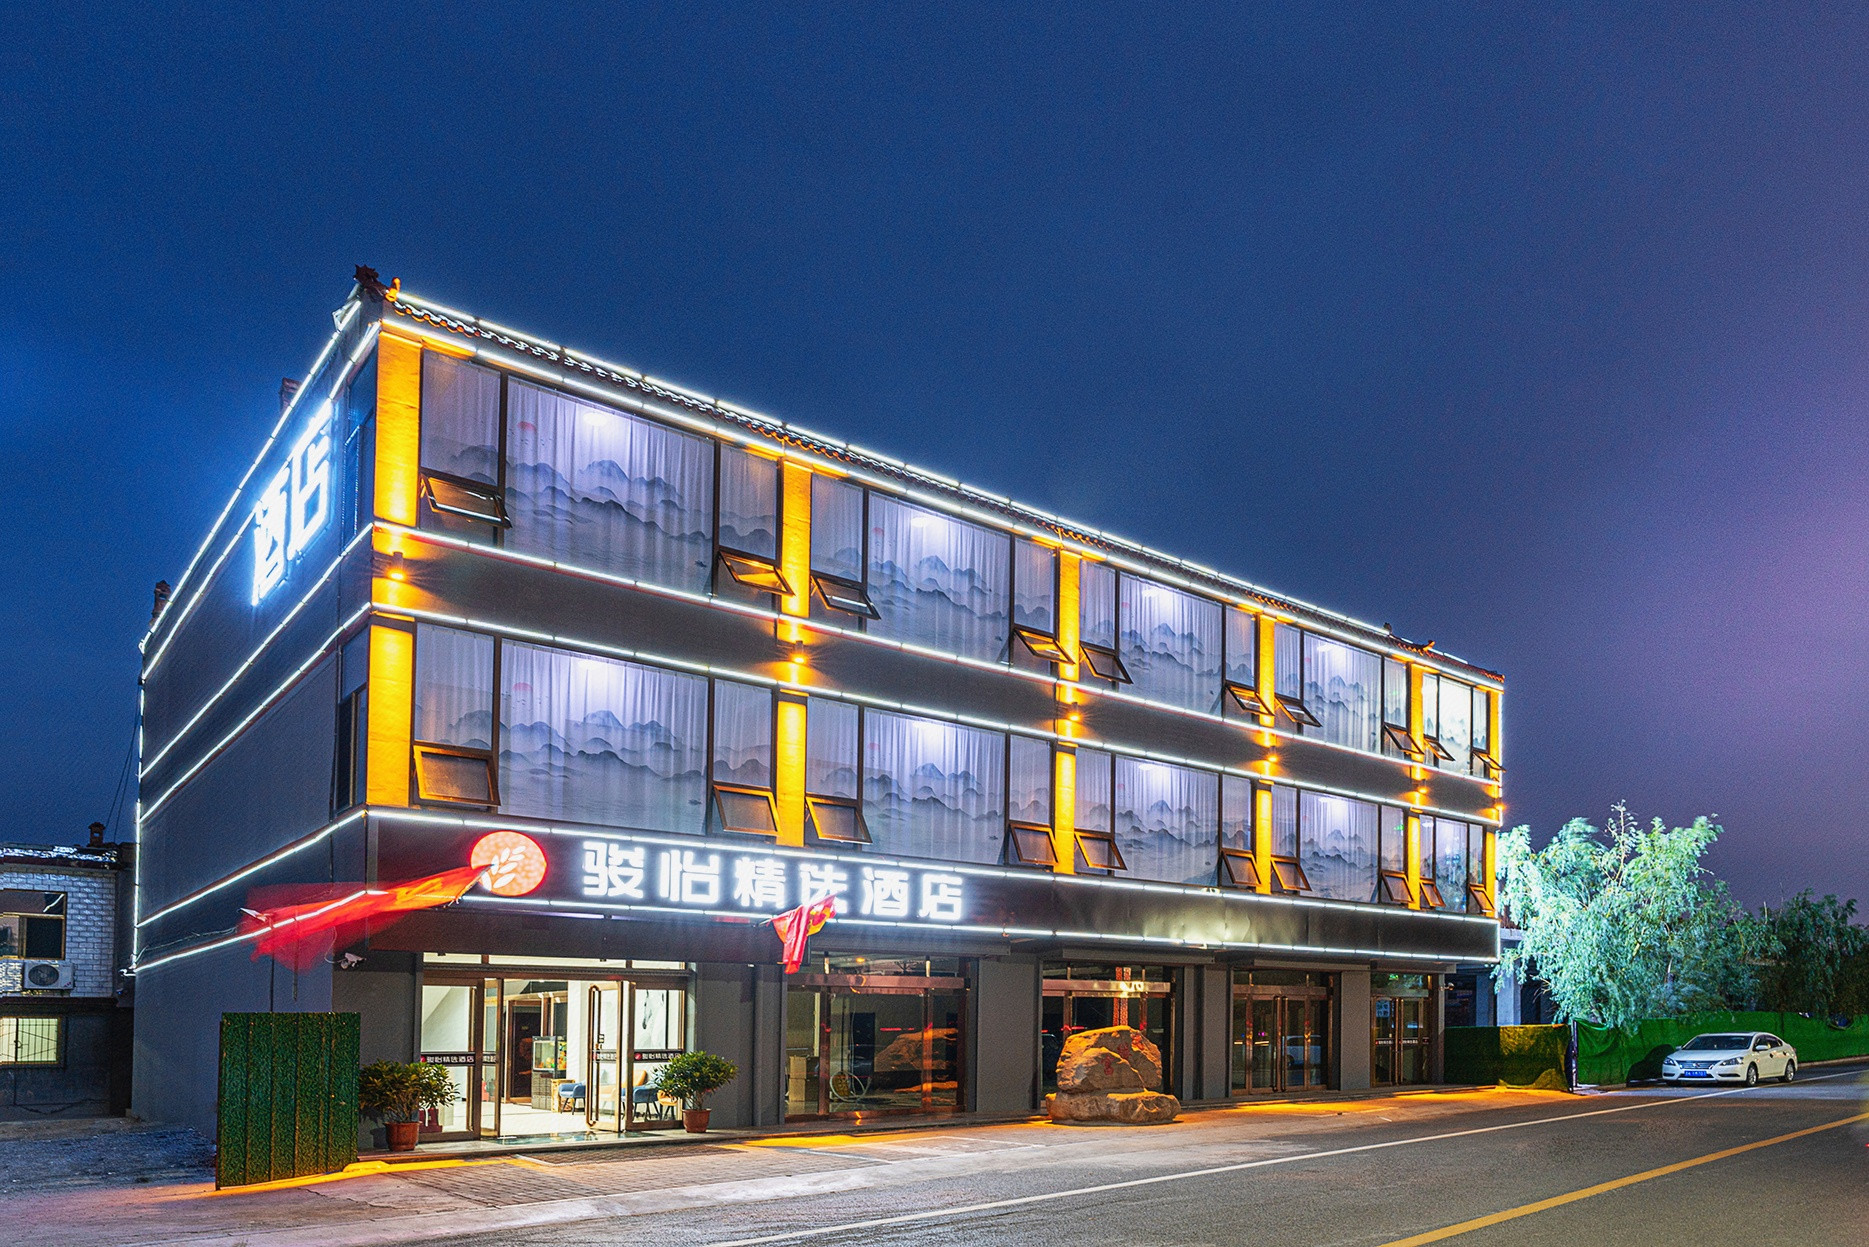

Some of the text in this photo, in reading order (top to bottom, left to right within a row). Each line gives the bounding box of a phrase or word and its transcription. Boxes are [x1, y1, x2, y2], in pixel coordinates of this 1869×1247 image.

[252, 398, 332, 606] 酒店
[582, 840, 964, 921] 骏怡精选酒店
